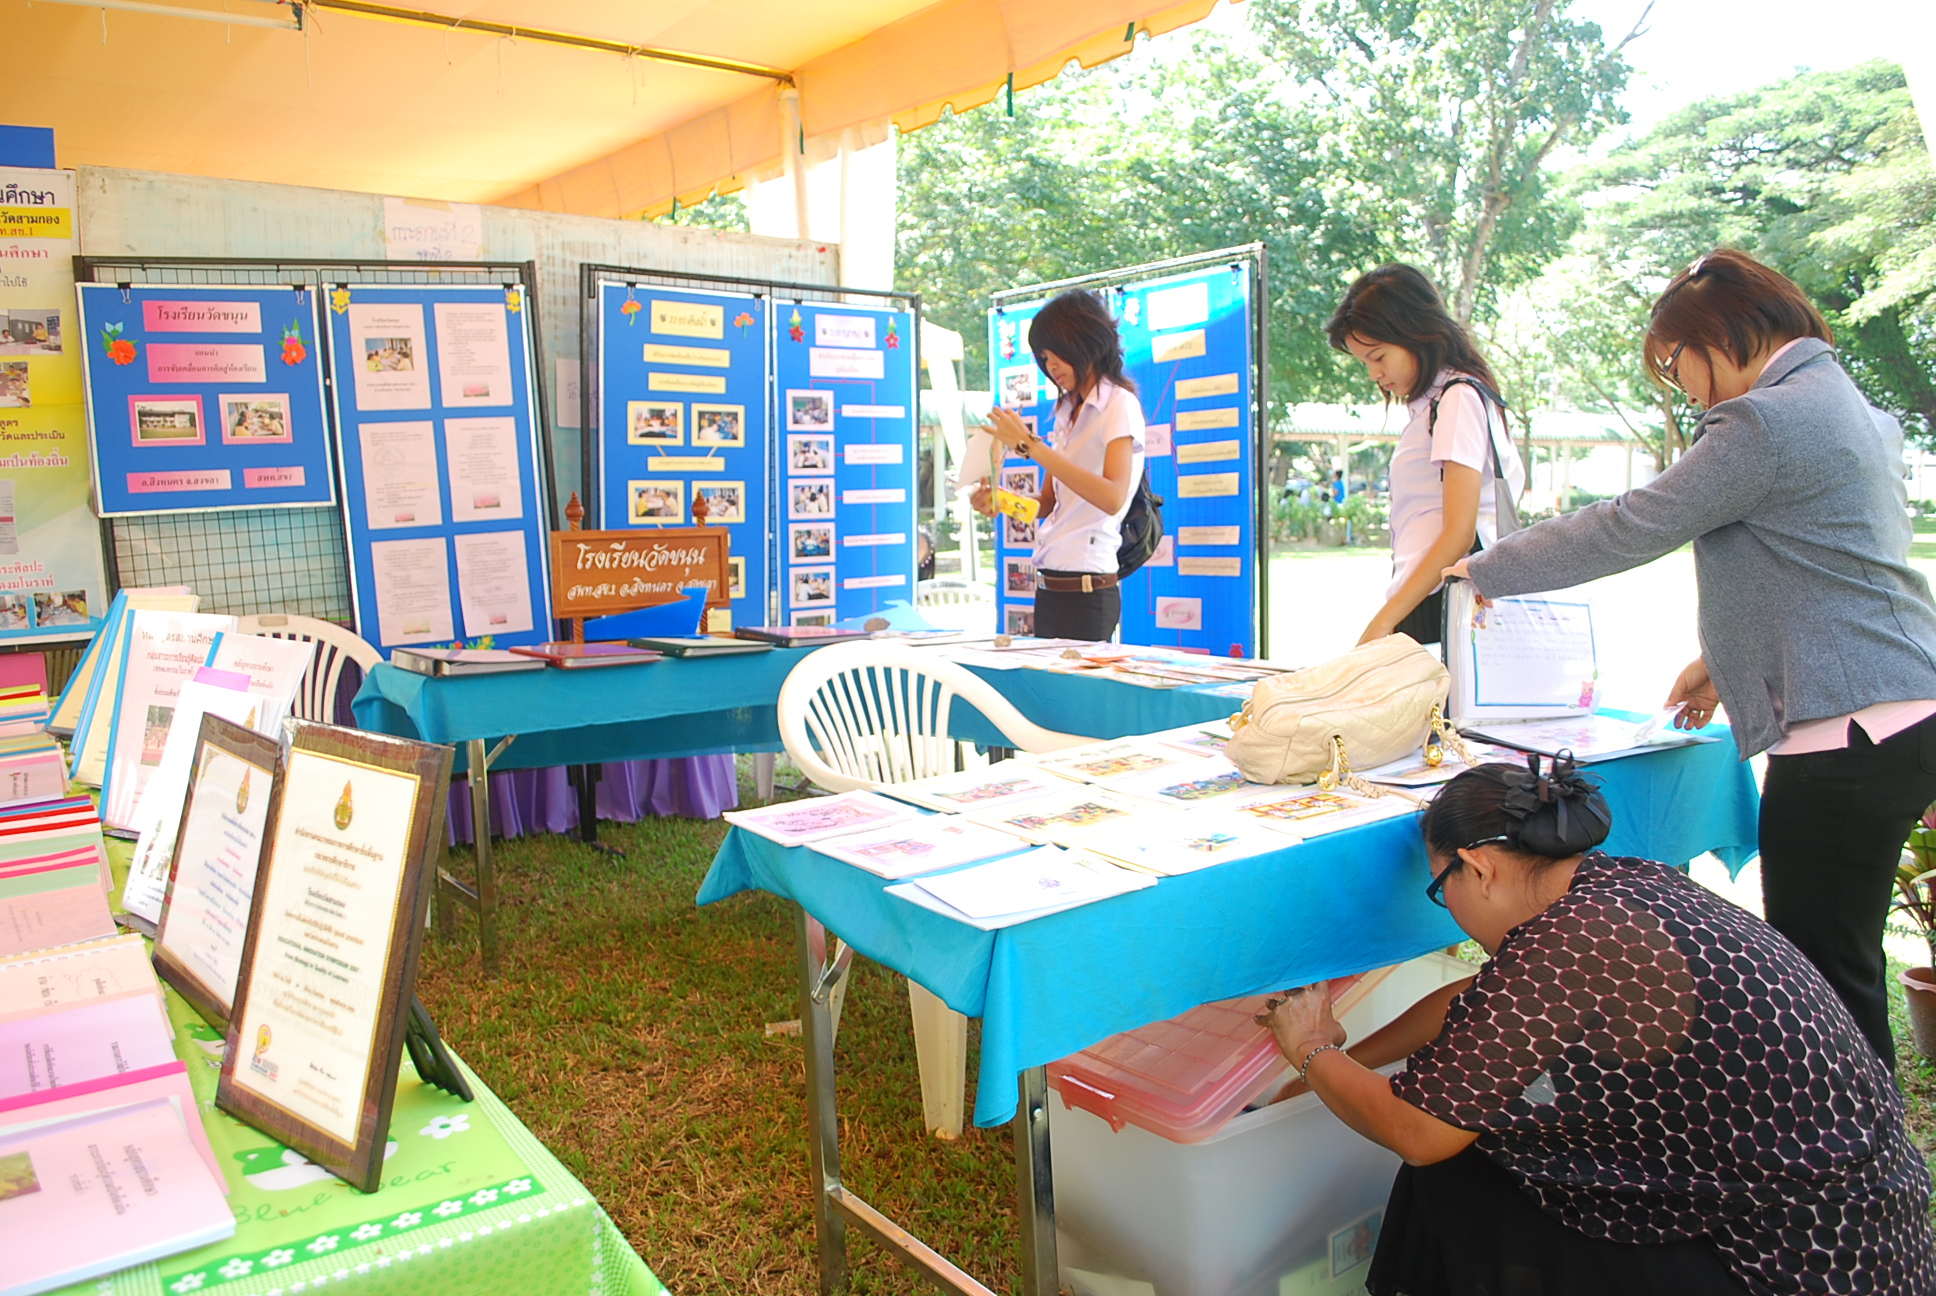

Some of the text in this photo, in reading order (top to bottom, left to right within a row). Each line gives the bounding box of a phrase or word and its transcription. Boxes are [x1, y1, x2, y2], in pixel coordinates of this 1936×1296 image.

[157, 305, 248, 325] โรงเรียนวัดขนุน
[0, 560, 43, 575] ระศิลปะ
[576, 541, 708, 576] โรงเรียนวัดขนุน
